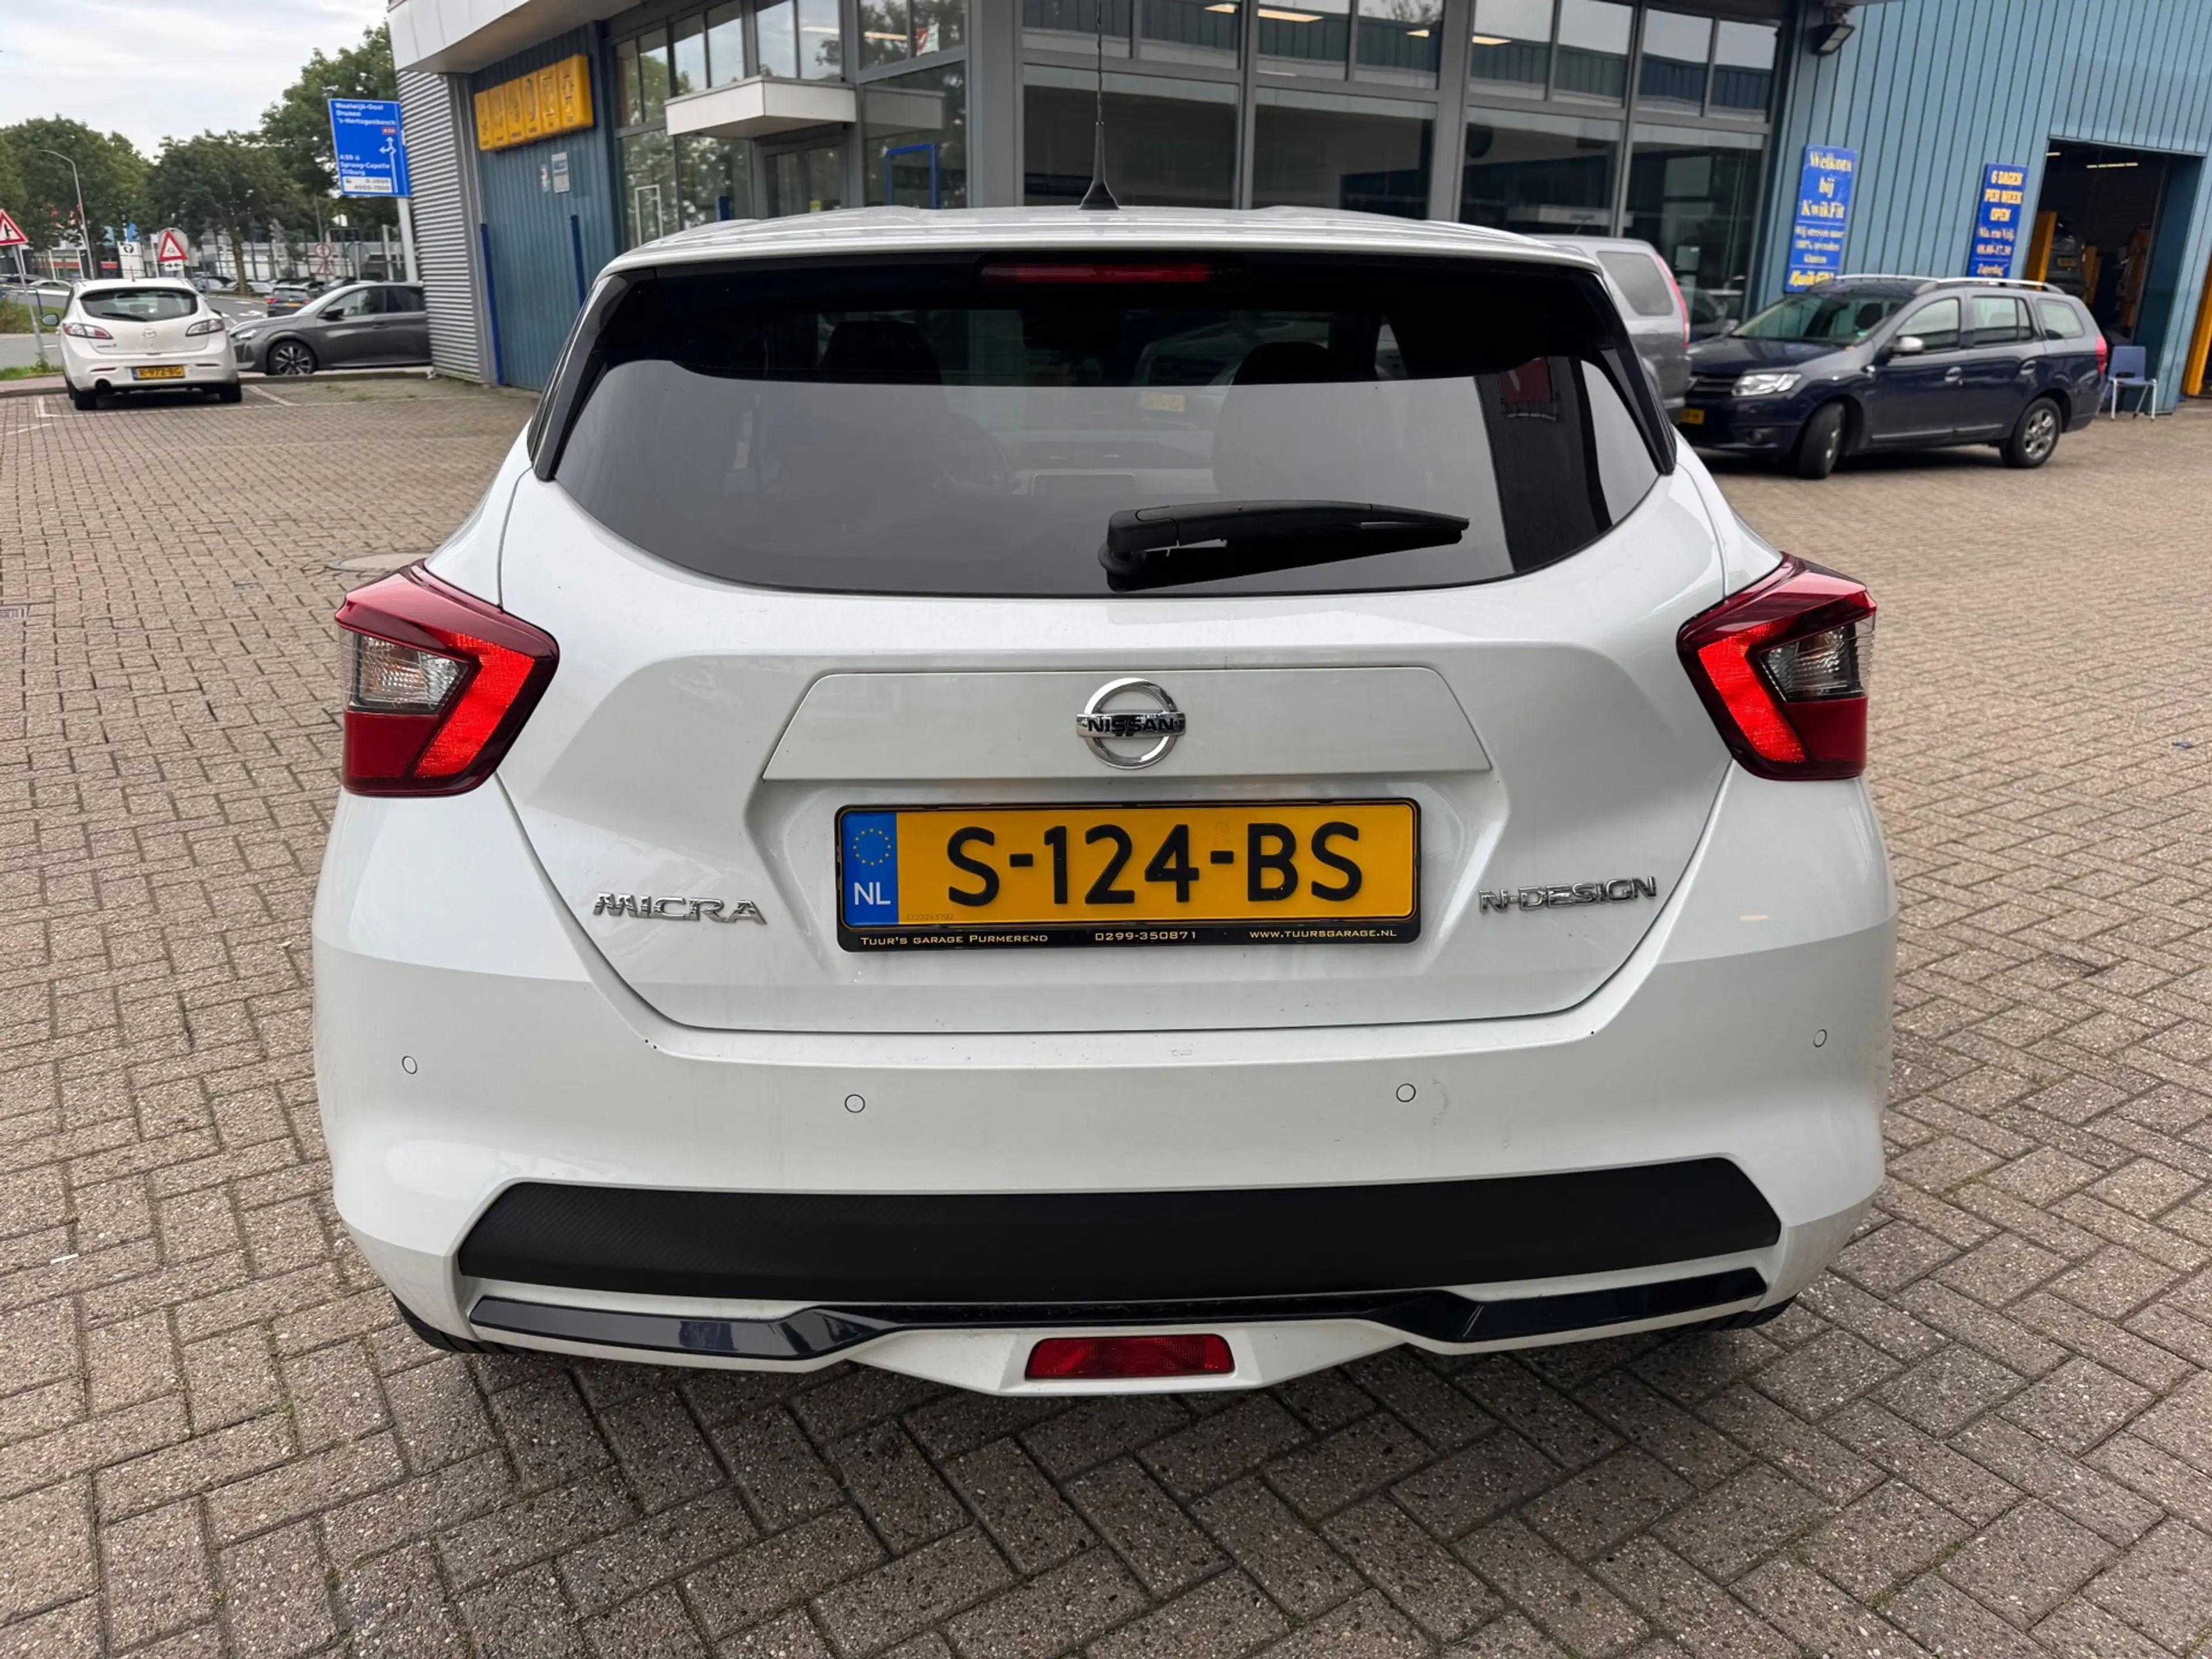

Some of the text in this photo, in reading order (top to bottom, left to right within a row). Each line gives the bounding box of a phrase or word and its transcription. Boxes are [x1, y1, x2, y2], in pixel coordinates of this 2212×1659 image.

[1088, 718, 1175, 734] NISSAN
[946, 821, 1362, 907] S-124-BS
[853, 881, 892, 906] NL
[1479, 876, 1657, 914] N-DESIGN
[592, 892, 768, 925] MICRA
[860, 937, 908, 946] TUUR'S
[912, 936, 964, 945] GARAGE
[968, 934, 1049, 944] PURMEREND
[1094, 931, 1196, 941] 0299-350871
